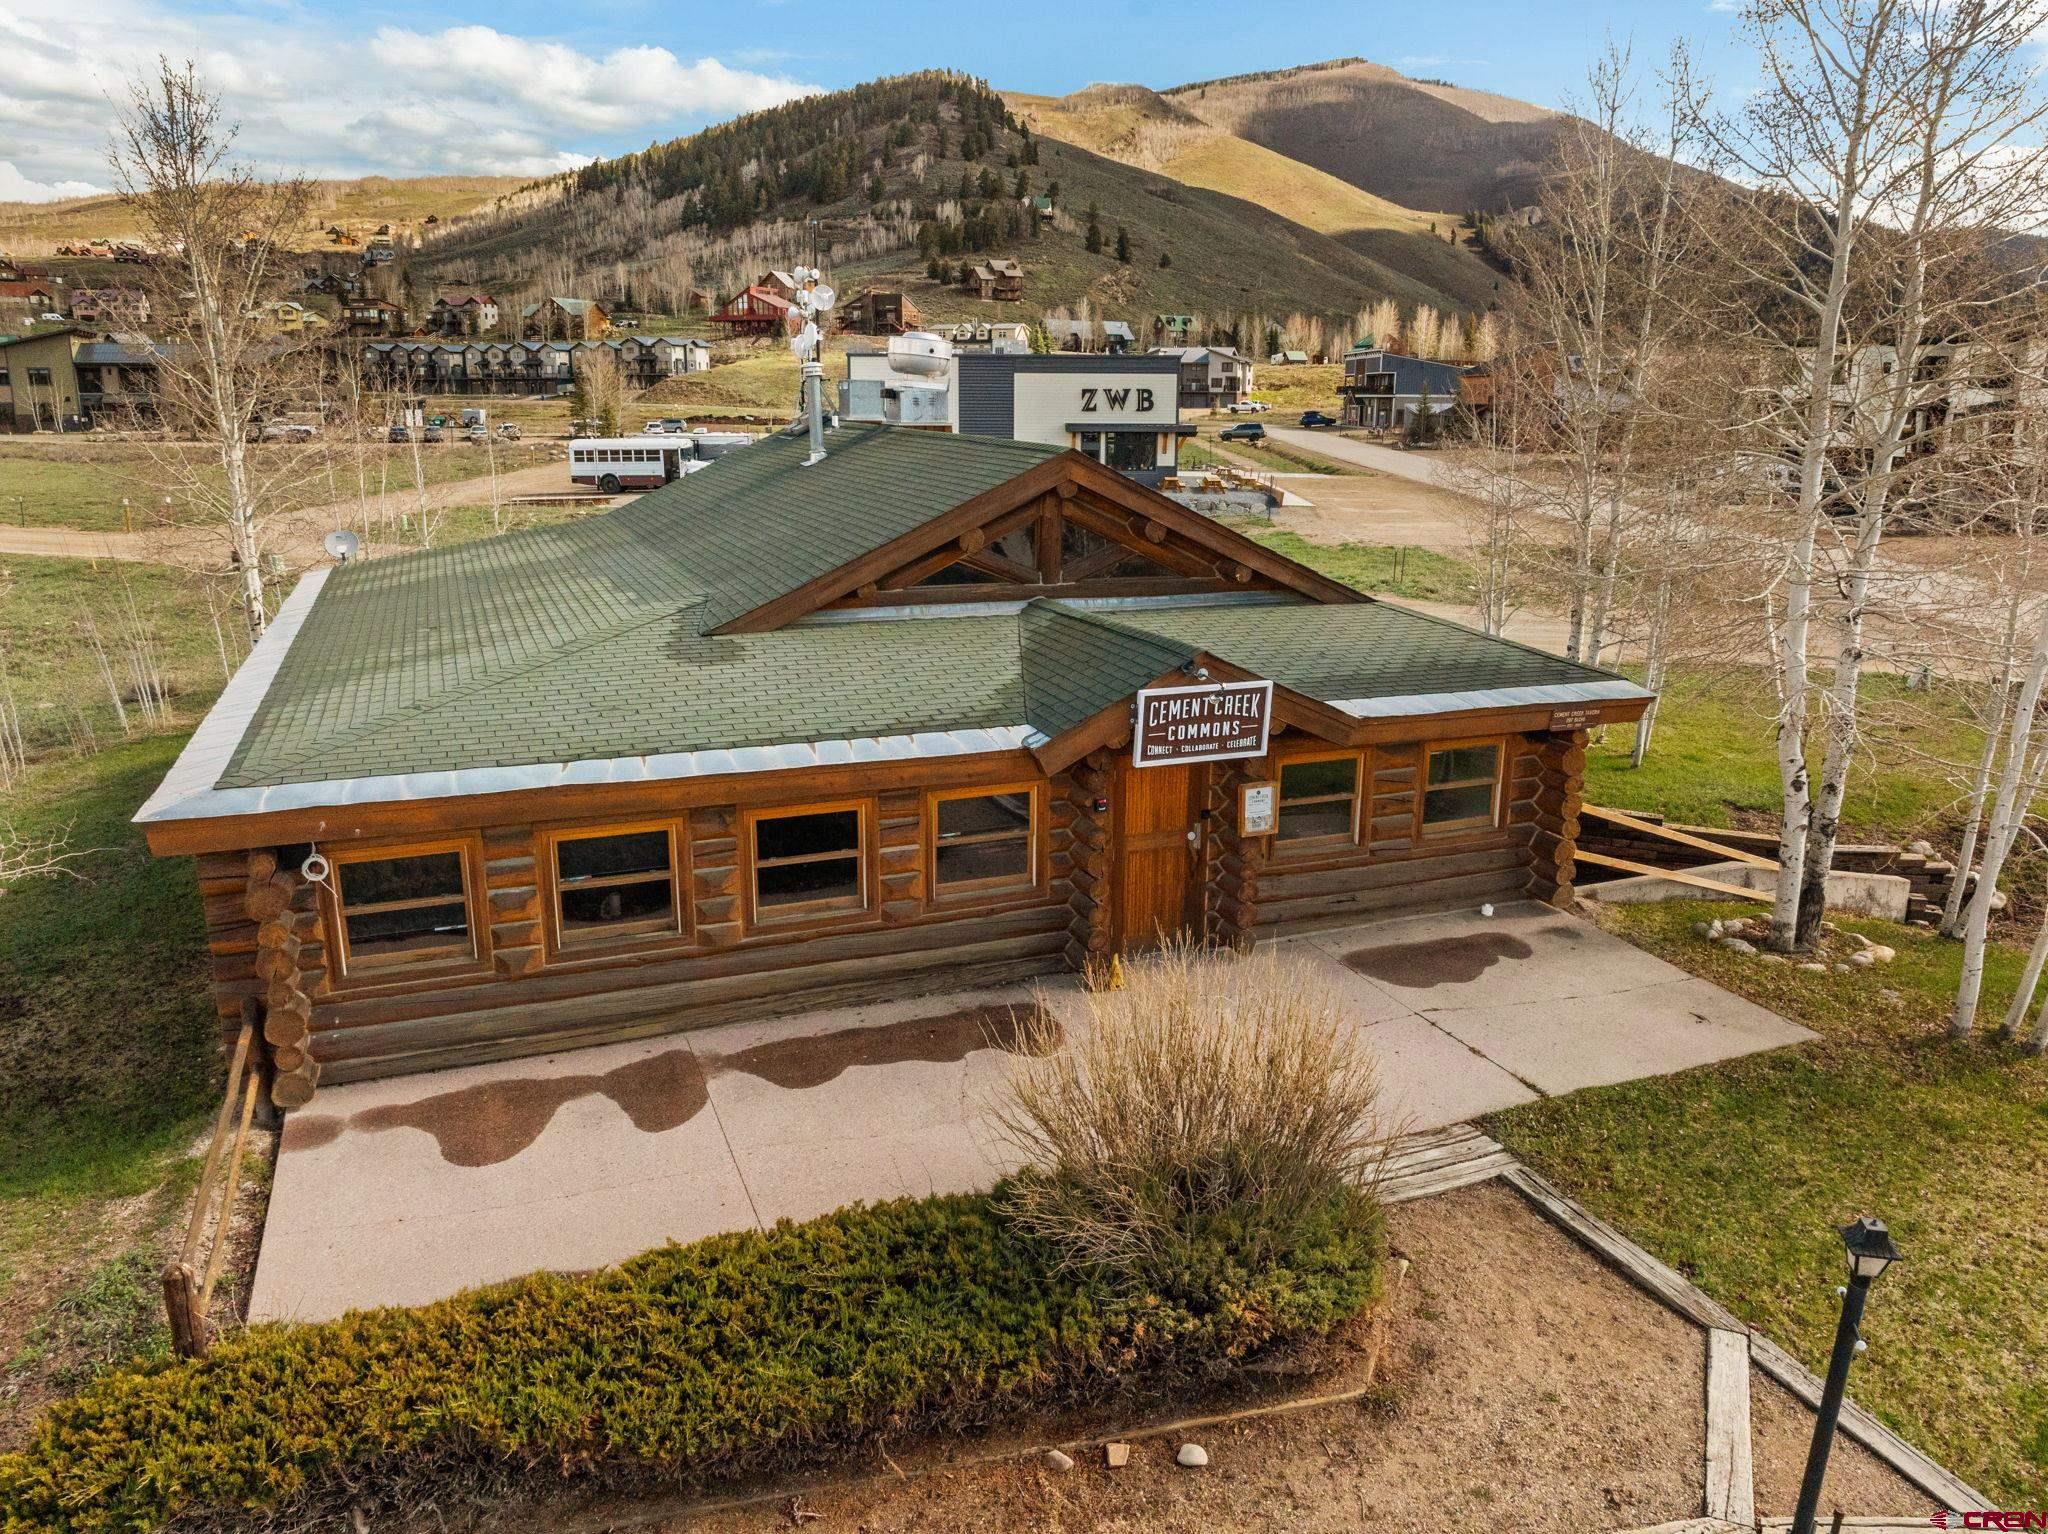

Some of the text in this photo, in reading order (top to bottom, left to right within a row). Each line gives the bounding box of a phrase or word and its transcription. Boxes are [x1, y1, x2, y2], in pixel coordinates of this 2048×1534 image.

[1081, 388, 1155, 412] ZWB
[1149, 693, 1261, 727] CEMENT CREEK
[1168, 720, 1240, 741] COMMONS
[1147, 736, 1257, 755] CONNECT COLLABORATE CELEBRATE
